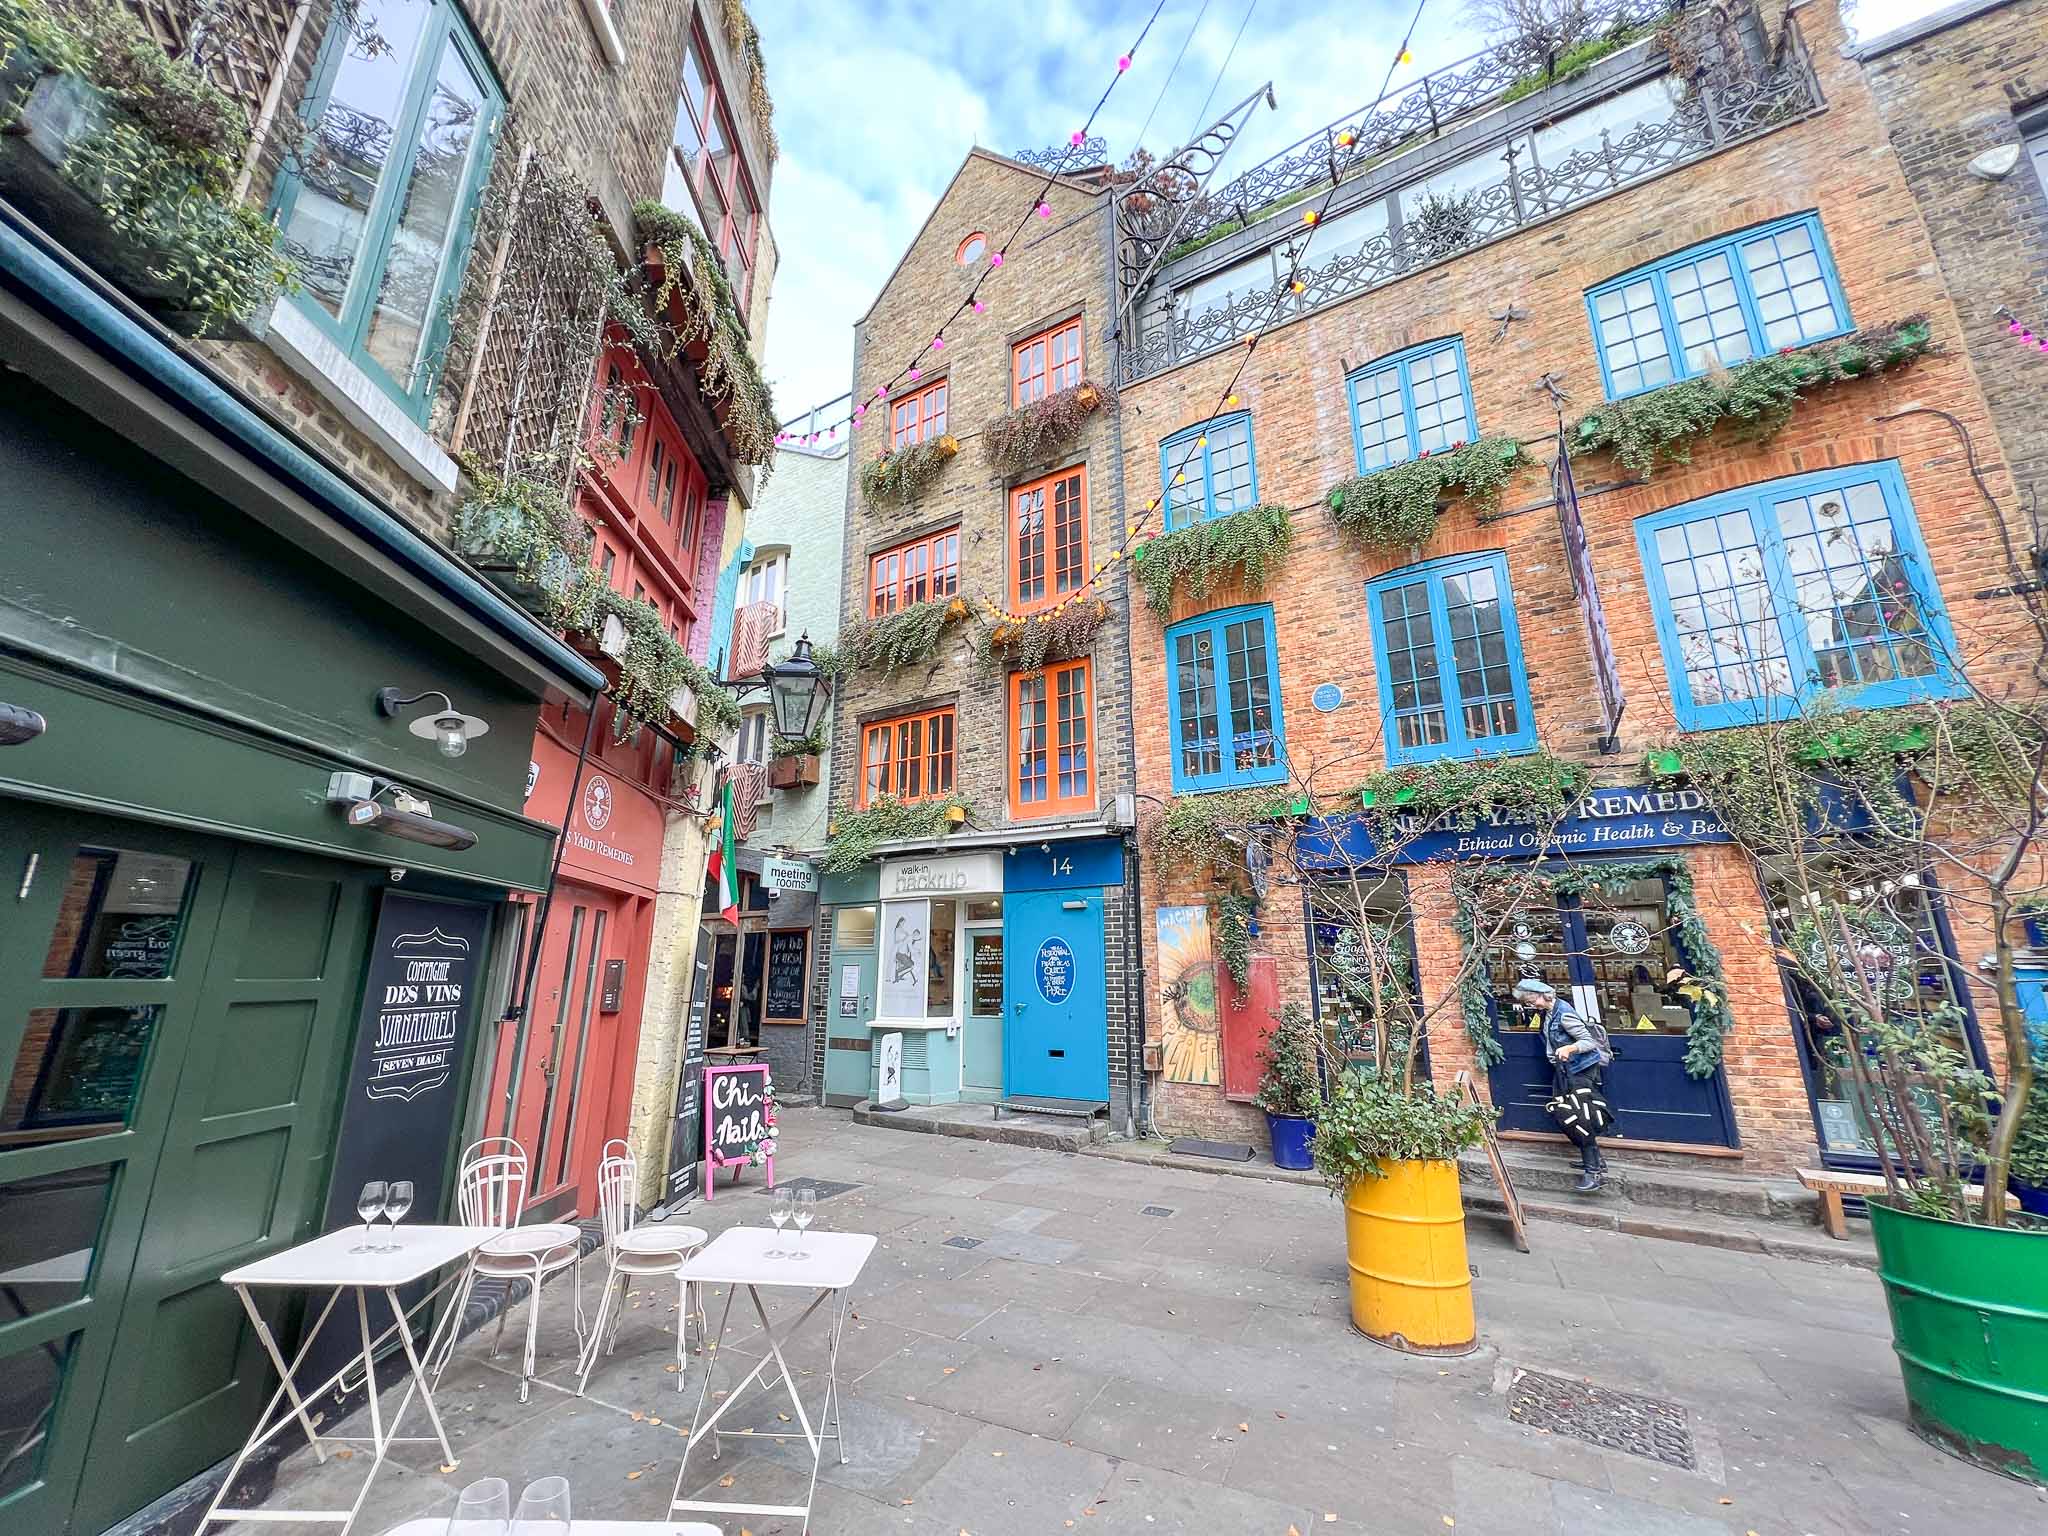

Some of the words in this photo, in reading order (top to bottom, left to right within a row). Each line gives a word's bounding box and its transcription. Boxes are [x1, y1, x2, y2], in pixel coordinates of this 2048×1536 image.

[1577, 789, 1705, 819] REMED
[1457, 834, 1514, 852] Ethical
[1592, 823, 1654, 842] Health
[1662, 821, 1684, 837] &
[1691, 819, 1728, 836] Bea
[574, 831, 596, 852] YARD
[597, 839, 633, 866] REMEDIES
[771, 868, 812, 883] meeting
[901, 863, 929, 876] walk-in
[1052, 856, 1073, 877] 14
[776, 878, 806, 890] rooms
[896, 866, 968, 893] backrub
[406, 960, 451, 982] COMPAGNIE
[384, 985, 418, 1005] DES
[426, 983, 462, 1003] VINS
[375, 1009, 457, 1047] SURNATURELS
[382, 1057, 414, 1073] SEVEN
[415, 1053, 442, 1068] DIALS
[713, 1075, 763, 1109] Chi
[712, 1110, 767, 1145] Nails
